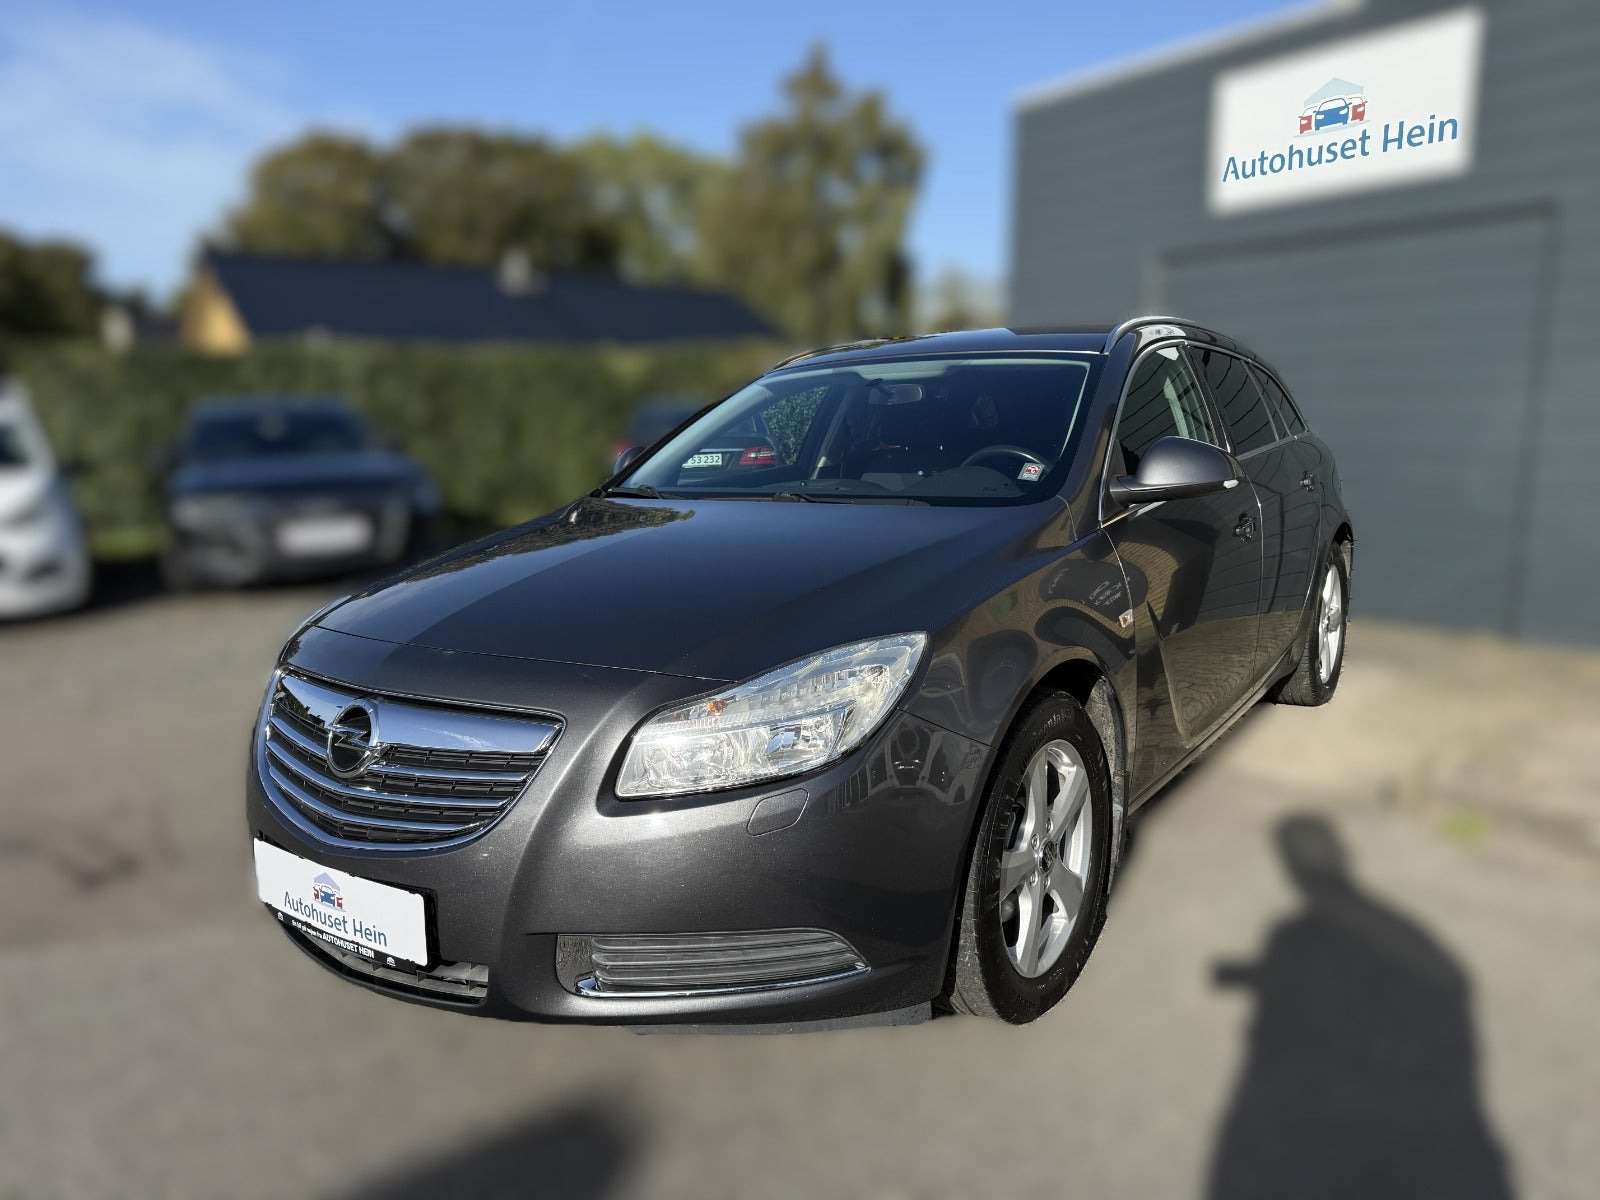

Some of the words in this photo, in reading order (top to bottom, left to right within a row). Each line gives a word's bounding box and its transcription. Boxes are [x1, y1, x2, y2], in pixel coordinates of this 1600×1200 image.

[1222, 129, 1370, 182] Autohuset
[1382, 114, 1458, 152] Hein
[691, 456, 702, 464] 53
[704, 455, 720, 463] 232
[284, 891, 348, 934] Autohuset
[353, 919, 387, 947] Hein
[323, 933, 358, 953] AUTOHUSET
[359, 946, 375, 958] HEIN
